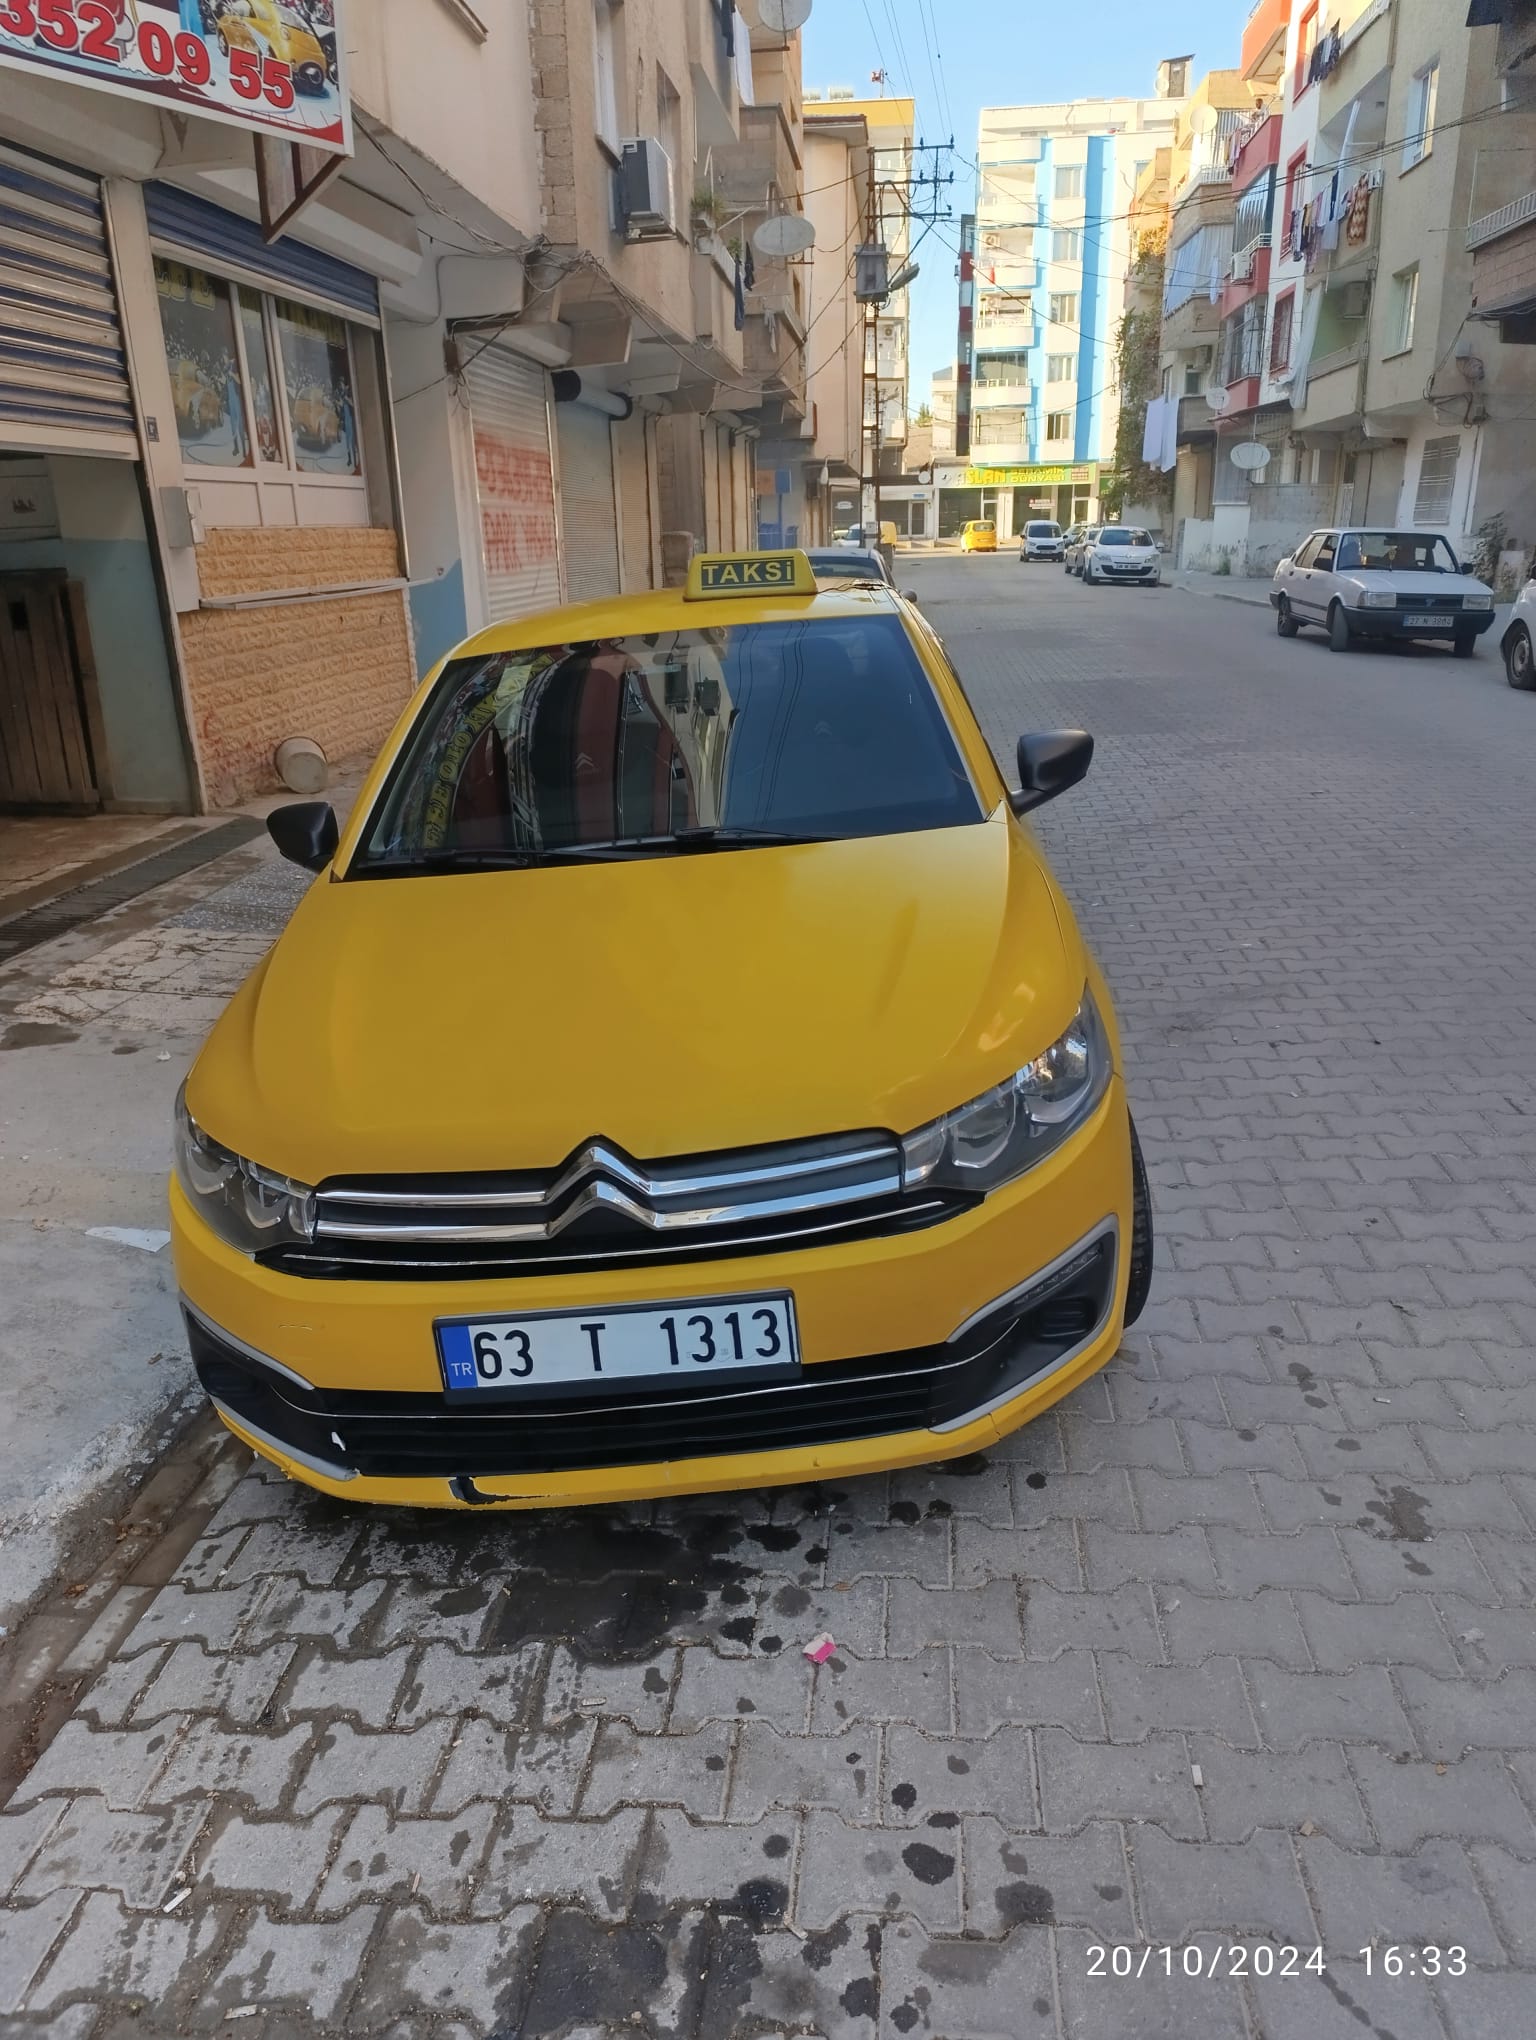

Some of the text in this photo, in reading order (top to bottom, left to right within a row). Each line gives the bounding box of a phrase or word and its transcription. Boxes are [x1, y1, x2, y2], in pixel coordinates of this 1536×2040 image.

[0, 0, 294, 109] 352 09 55
[451, 1362, 473, 1378] TR
[474, 1308, 781, 1379] 63 T 1313
